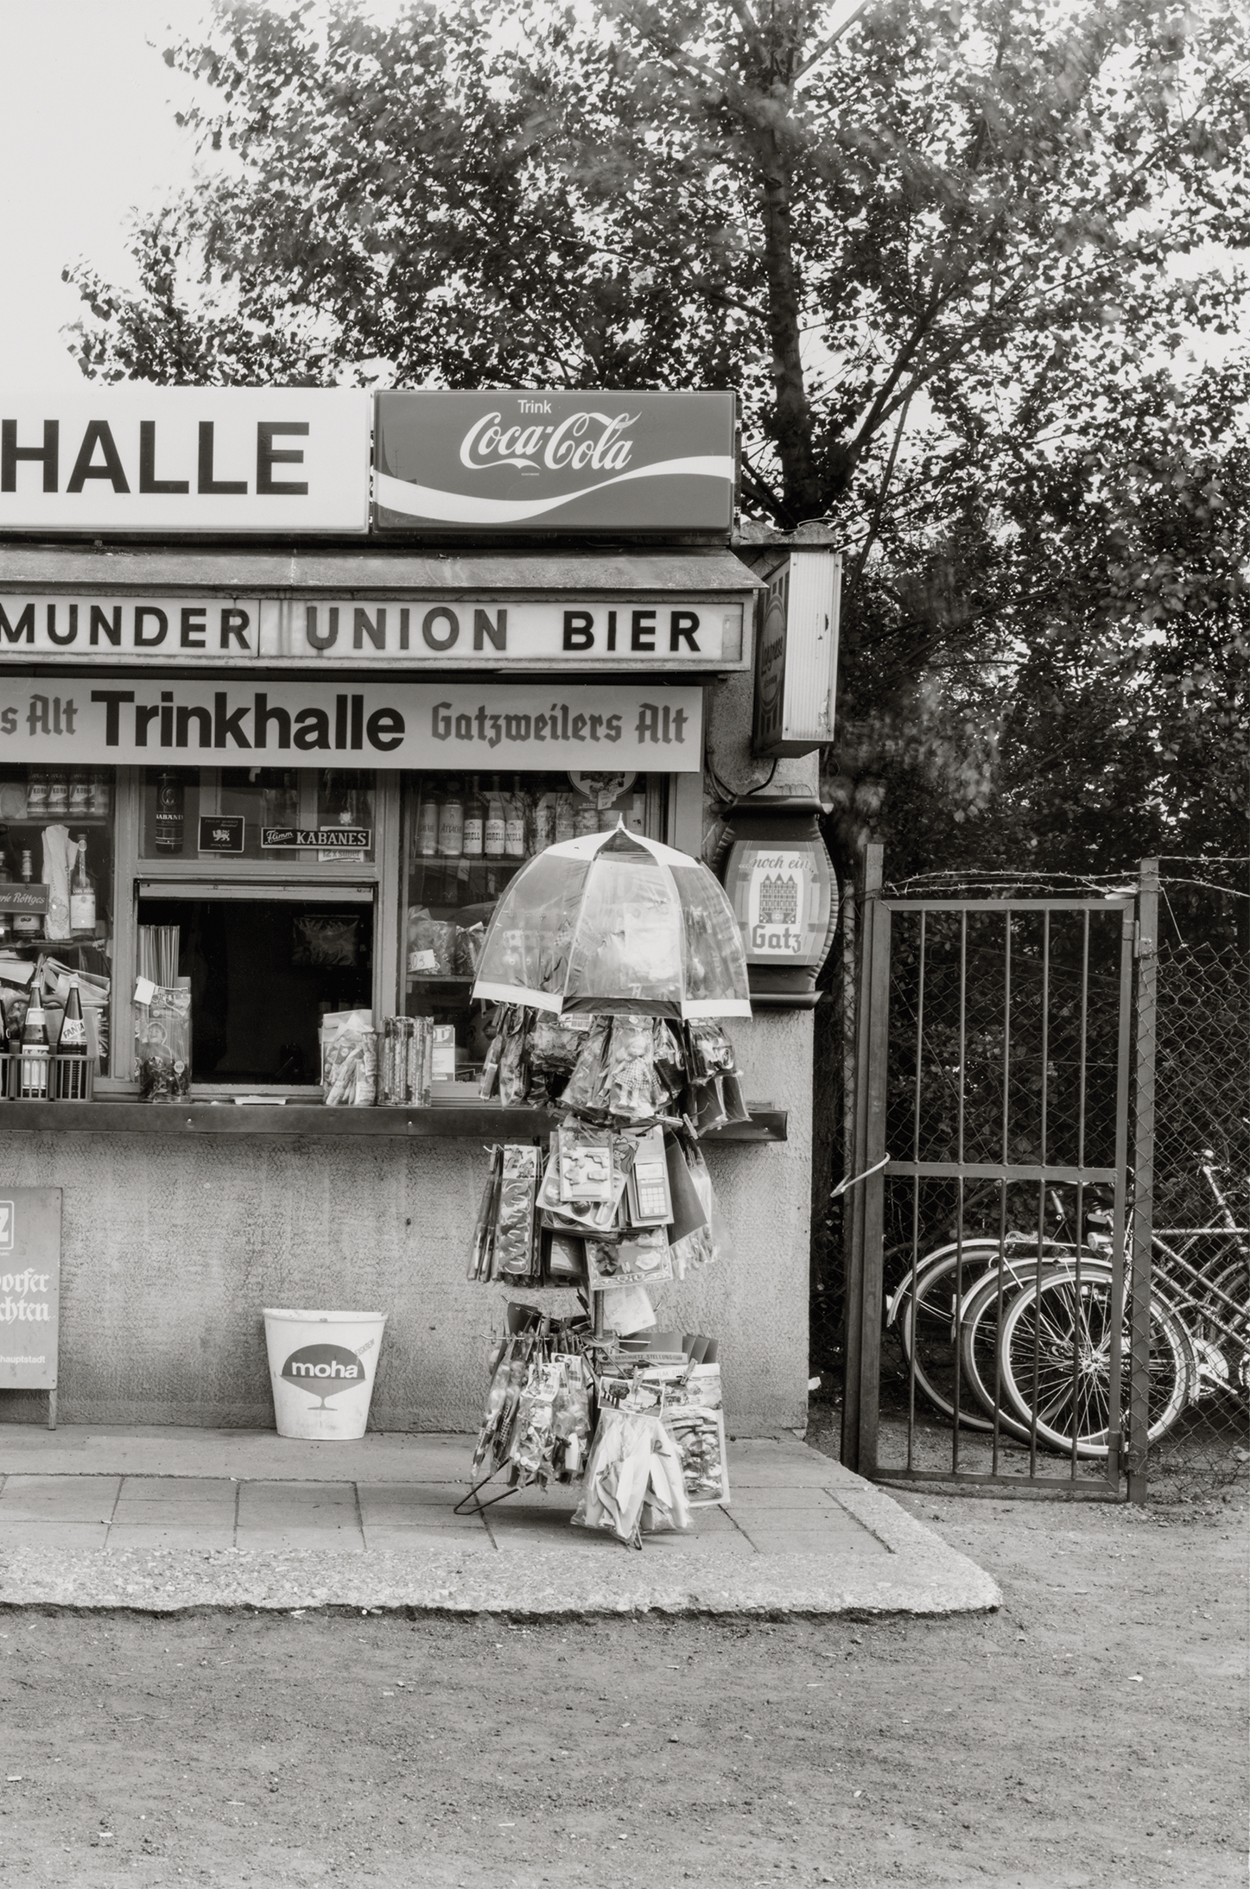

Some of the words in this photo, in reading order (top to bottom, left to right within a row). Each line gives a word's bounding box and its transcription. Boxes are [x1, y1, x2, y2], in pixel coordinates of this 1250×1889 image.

[518, 399, 552, 414] Trink
[459, 410, 642, 470] Coca-Cola
[306, 606, 508, 652] UNION
[562, 610, 702, 652] BIER
[25, 693, 79, 738] Alt
[91, 690, 406, 752] Trinkhalle
[431, 702, 624, 748] Gatzweilers
[636, 704, 690, 746] Alt
[296, 831, 367, 846] KABÄNES
[13, 892, 46, 906] Röttges
[752, 924, 802, 954] Gatz
[63, 1022, 85, 1039] FANTA
[291, 1360, 358, 1378] moha
